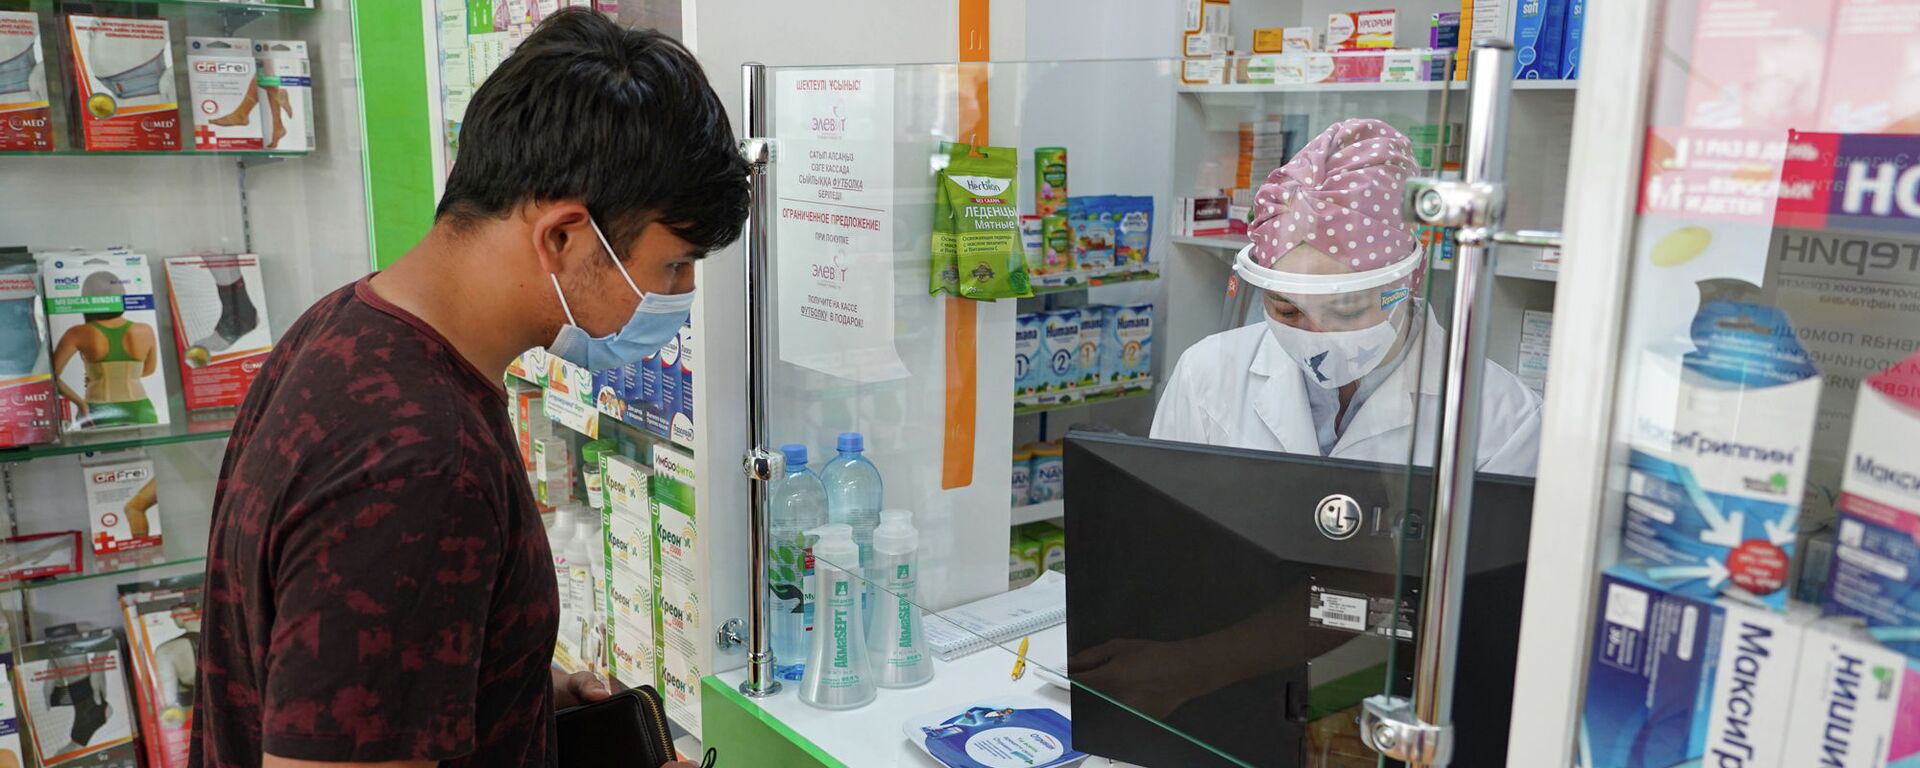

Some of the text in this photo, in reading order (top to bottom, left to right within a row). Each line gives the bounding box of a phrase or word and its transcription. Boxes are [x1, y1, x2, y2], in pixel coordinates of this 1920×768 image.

[832, 178, 863, 190] ФУТБОЛКА
[968, 179, 1001, 192] Herbion
[782, 208, 829, 225] ОГРАНИЧЕННОЕ
[964, 206, 1016, 219] ЛЕДЕНЦЫ
[974, 219, 1015, 229] Мятные
[815, 232, 826, 241] ПРИ
[833, 300, 840, 309] НА
[841, 302, 858, 313] КАССЕ
[1046, 325, 1078, 338] Humana
[1117, 318, 1149, 329] Humana
[1057, 354, 1067, 371] 2
[605, 474, 626, 494] Креон
[608, 531, 628, 553] Креон
[656, 522, 682, 548] Креон
[610, 587, 630, 608] Креон
[660, 594, 684, 620] Креон
[613, 641, 633, 665] Креон
[661, 666, 686, 692] Креон
